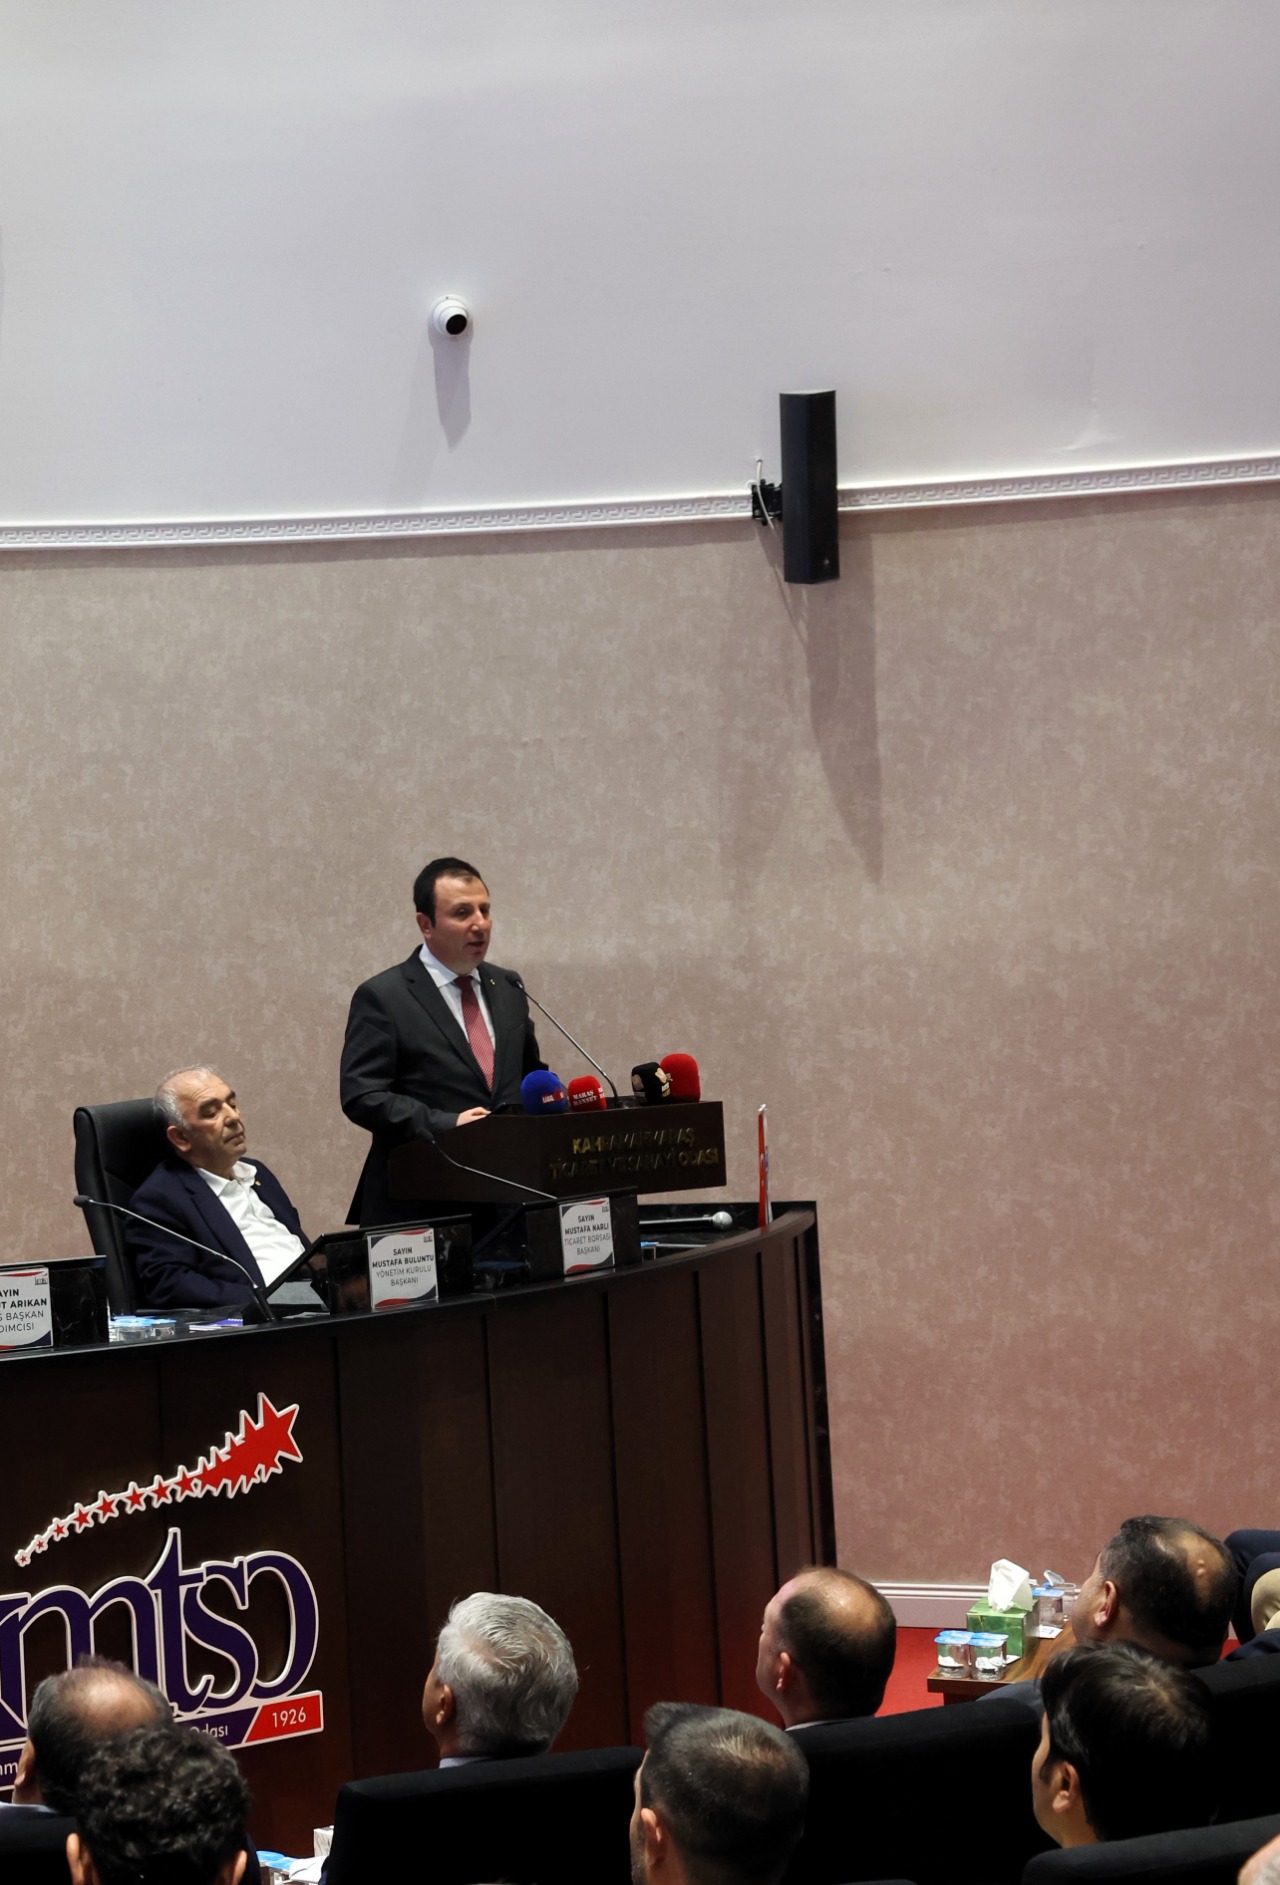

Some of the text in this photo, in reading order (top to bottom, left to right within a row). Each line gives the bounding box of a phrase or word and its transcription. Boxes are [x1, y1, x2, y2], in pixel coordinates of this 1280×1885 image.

[10, 1298, 48, 1309] ARIKAN
[6, 1310, 44, 1322] BAŞKAN
[272, 1706, 307, 1728] 1926
